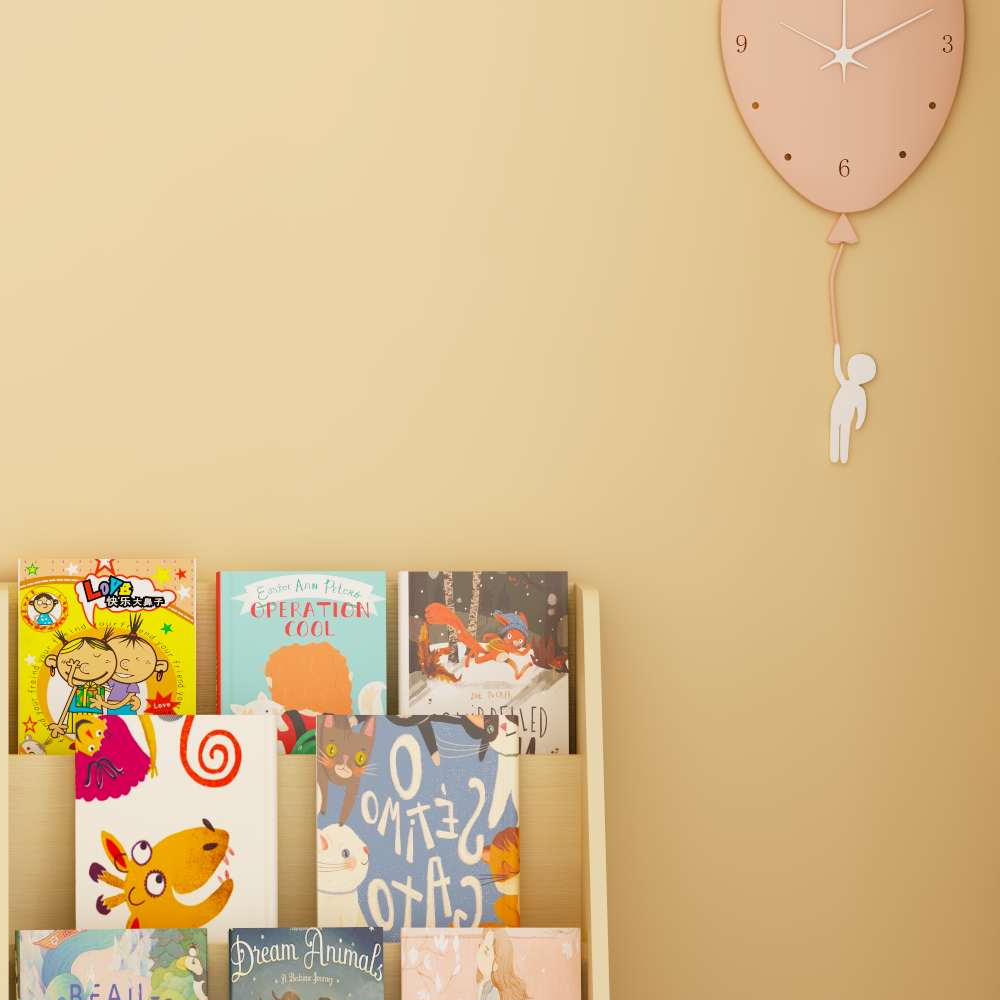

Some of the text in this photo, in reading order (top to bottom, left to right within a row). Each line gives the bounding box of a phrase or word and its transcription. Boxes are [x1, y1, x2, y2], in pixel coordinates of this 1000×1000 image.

[736, 34, 748, 53] 9
[942, 34, 953, 53] 3
[838, 158, 850, 177] 6
[256, 583, 292, 600] Easter
[105, 595, 165, 608] 快乐大鼻子
[250, 601, 370, 618] OPERATION
[285, 620, 336, 637] COOL
[230, 927, 383, 983] Dream Animals
[313, 972, 334, 986] Journey
